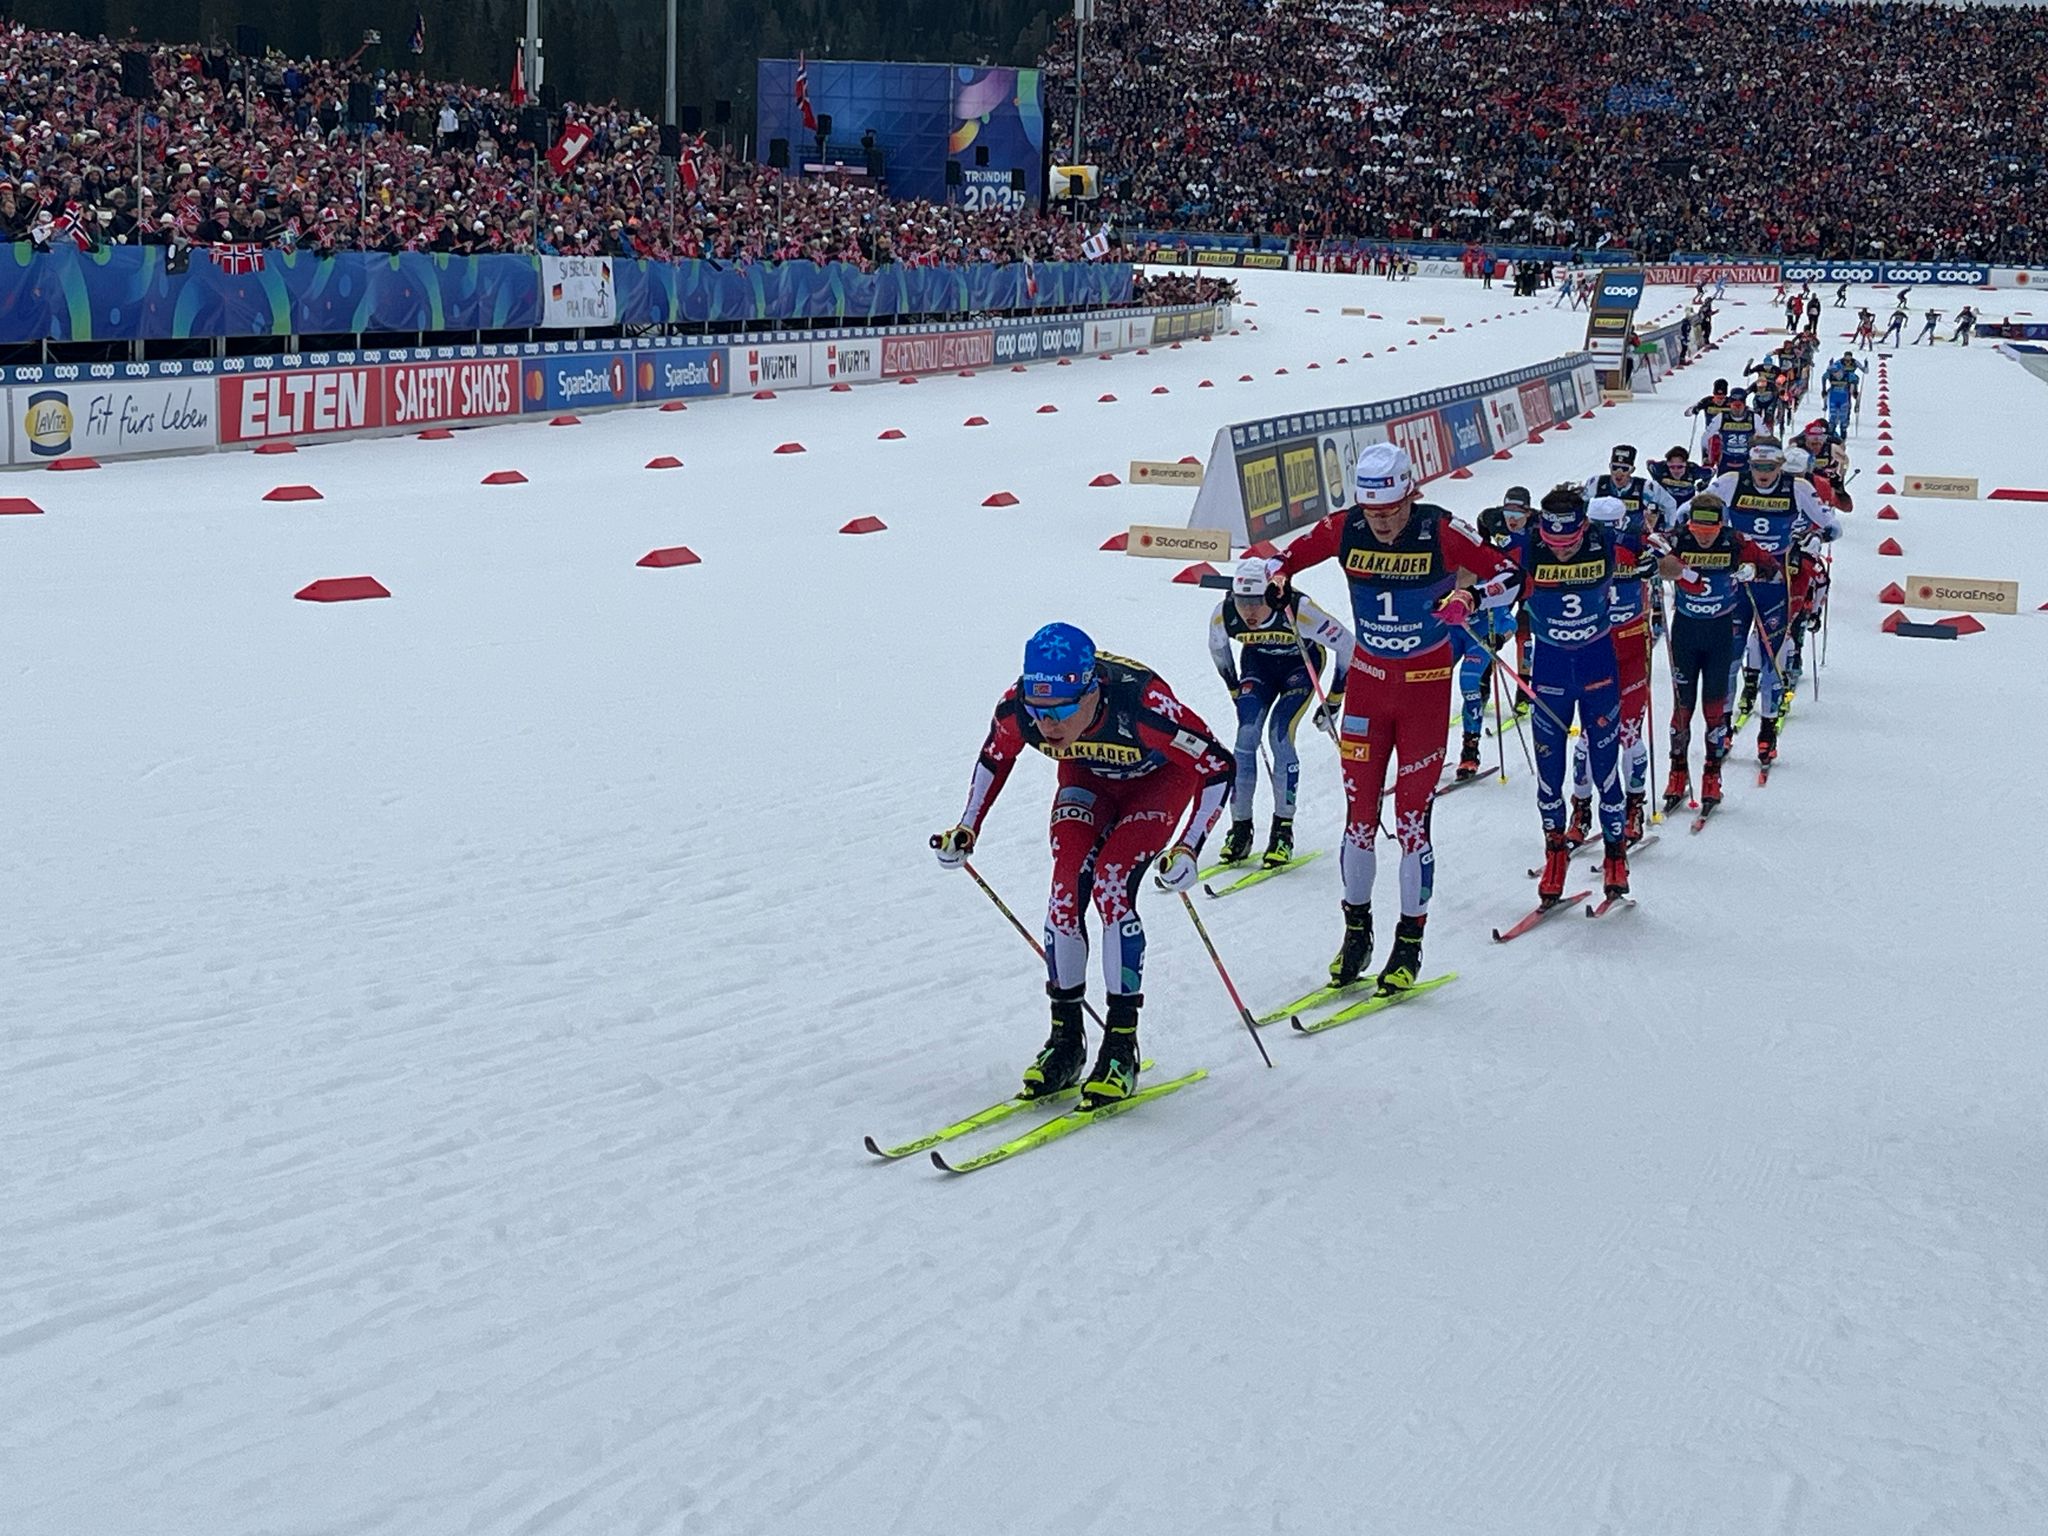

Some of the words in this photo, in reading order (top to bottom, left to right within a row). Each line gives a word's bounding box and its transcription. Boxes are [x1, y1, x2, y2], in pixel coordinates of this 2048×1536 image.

[964, 170, 1012, 183] TRONDH
[1646, 268, 1687, 284] NERALI
[1785, 268, 1826, 282] coop
[1831, 268, 1873, 283] coop
[1887, 268, 1932, 284] coop
[1937, 269, 1982, 284] coop
[1603, 286, 1638, 298] coop
[996, 333, 1016, 360] coop
[1018, 332, 1038, 359] coop
[761, 354, 798, 381] WÜRTH
[838, 349, 871, 374] WÜRTH
[15, 366, 43, 382] coop
[54, 365, 79, 380] coop
[90, 364, 115, 379] coop
[126, 363, 150, 378] coop
[160, 361, 183, 375] coop
[665, 361, 710, 391] SpareBank
[558, 368, 612, 400] SpareBank
[394, 366, 455, 422] SAFETY
[460, 363, 510, 415] SHOES
[240, 371, 367, 438] ELTEN
[86, 393, 114, 436] Fit
[119, 395, 155, 445] fürs
[161, 387, 208, 430] Leben
[1753, 517, 1770, 534] 8
[1155, 536, 1218, 550] StoraEnso
[1350, 553, 1428, 573] BLÅKLÄDER
[1538, 564, 1602, 580] BLÅKLÄDER
[1936, 587, 2005, 602] StoraEnso
[1376, 592, 1399, 622] 1
[1561, 594, 1582, 618] 3
[1685, 602, 1722, 615] coop
[1610, 611, 1635, 622] op
[1359, 618, 1423, 633] TRONDHEIM
[1548, 625, 1598, 641] coop
[1363, 632, 1421, 652] coop
[1543, 818, 1556, 830] 3
[1611, 821, 1622, 836] 3
